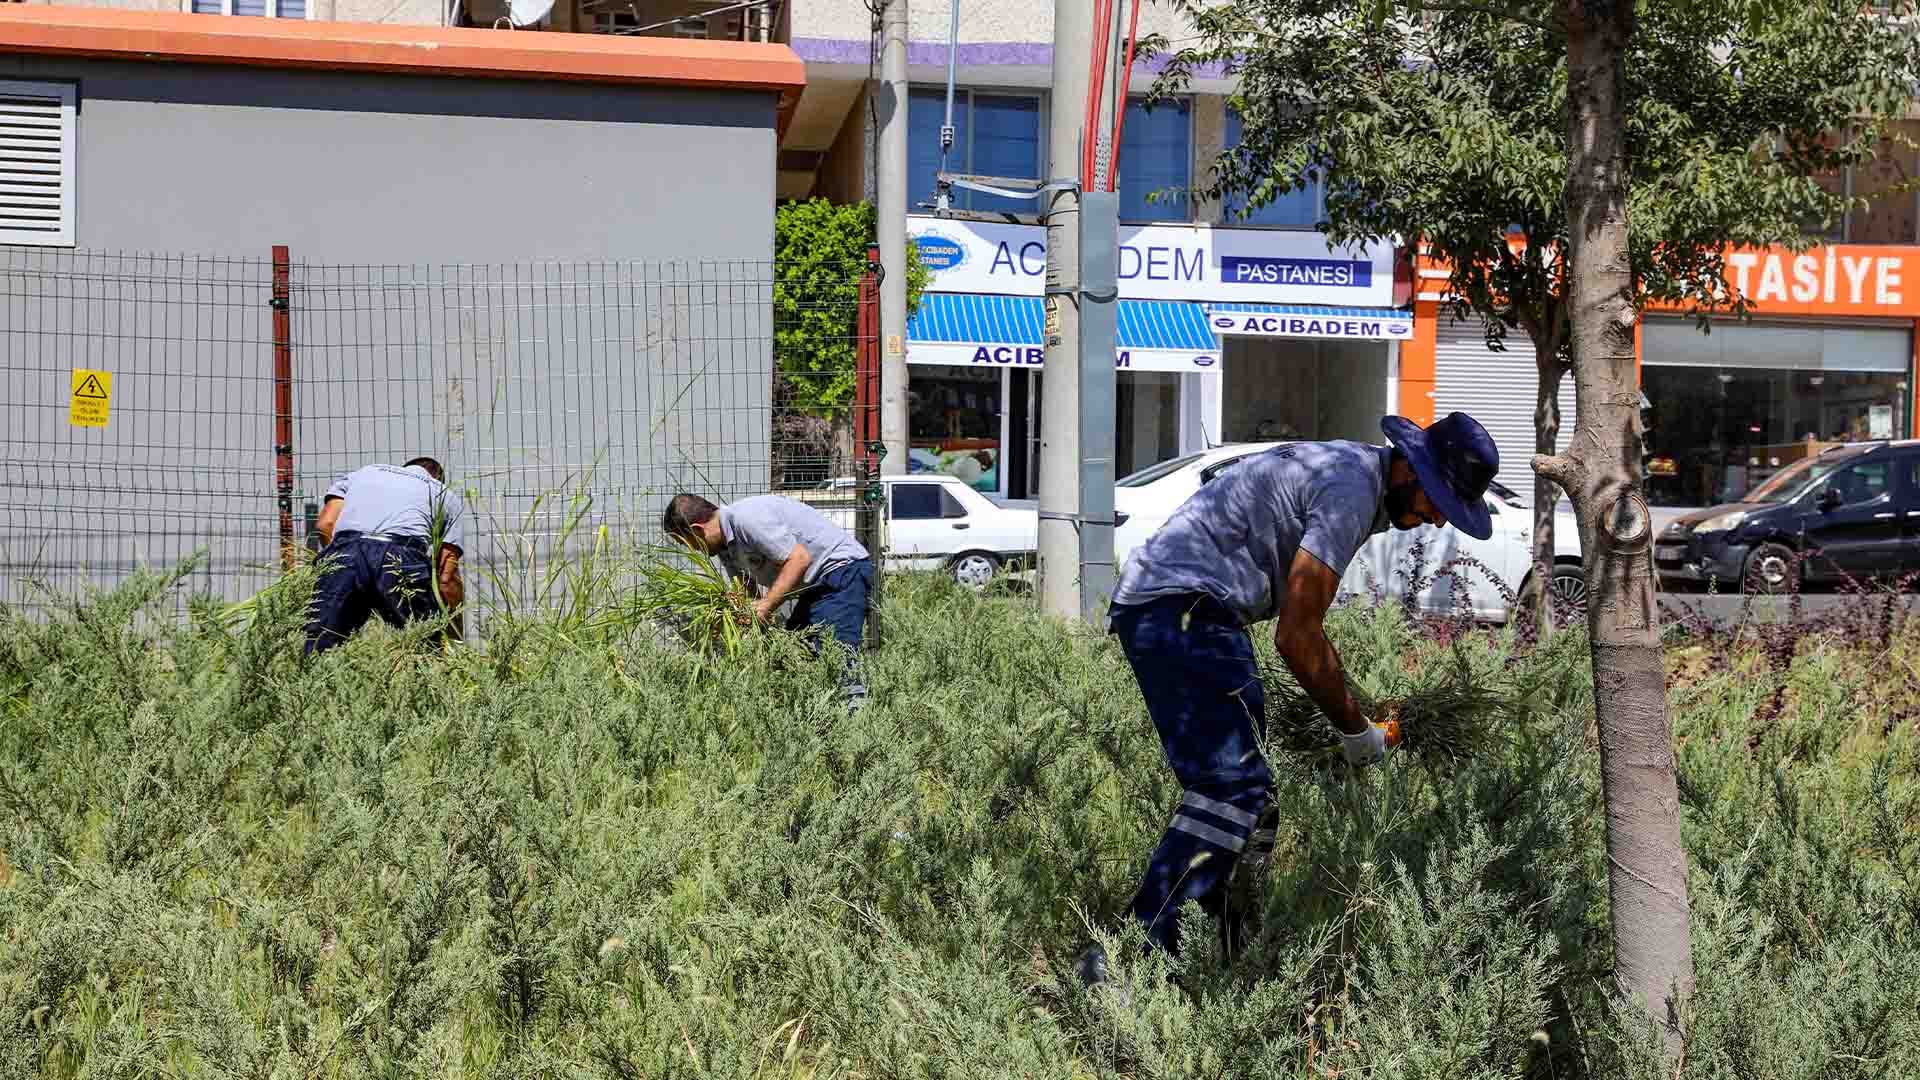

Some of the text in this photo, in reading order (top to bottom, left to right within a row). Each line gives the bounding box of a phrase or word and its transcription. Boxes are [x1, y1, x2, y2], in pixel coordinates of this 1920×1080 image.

[989, 240, 1204, 281] ACDEM
[1236, 262, 1354, 285] PASTANESİ
[1640, 246, 1903, 304] TASİYE
[1243, 317, 1381, 337] ACIBADEM
[971, 346, 1131, 368] ACIBM
